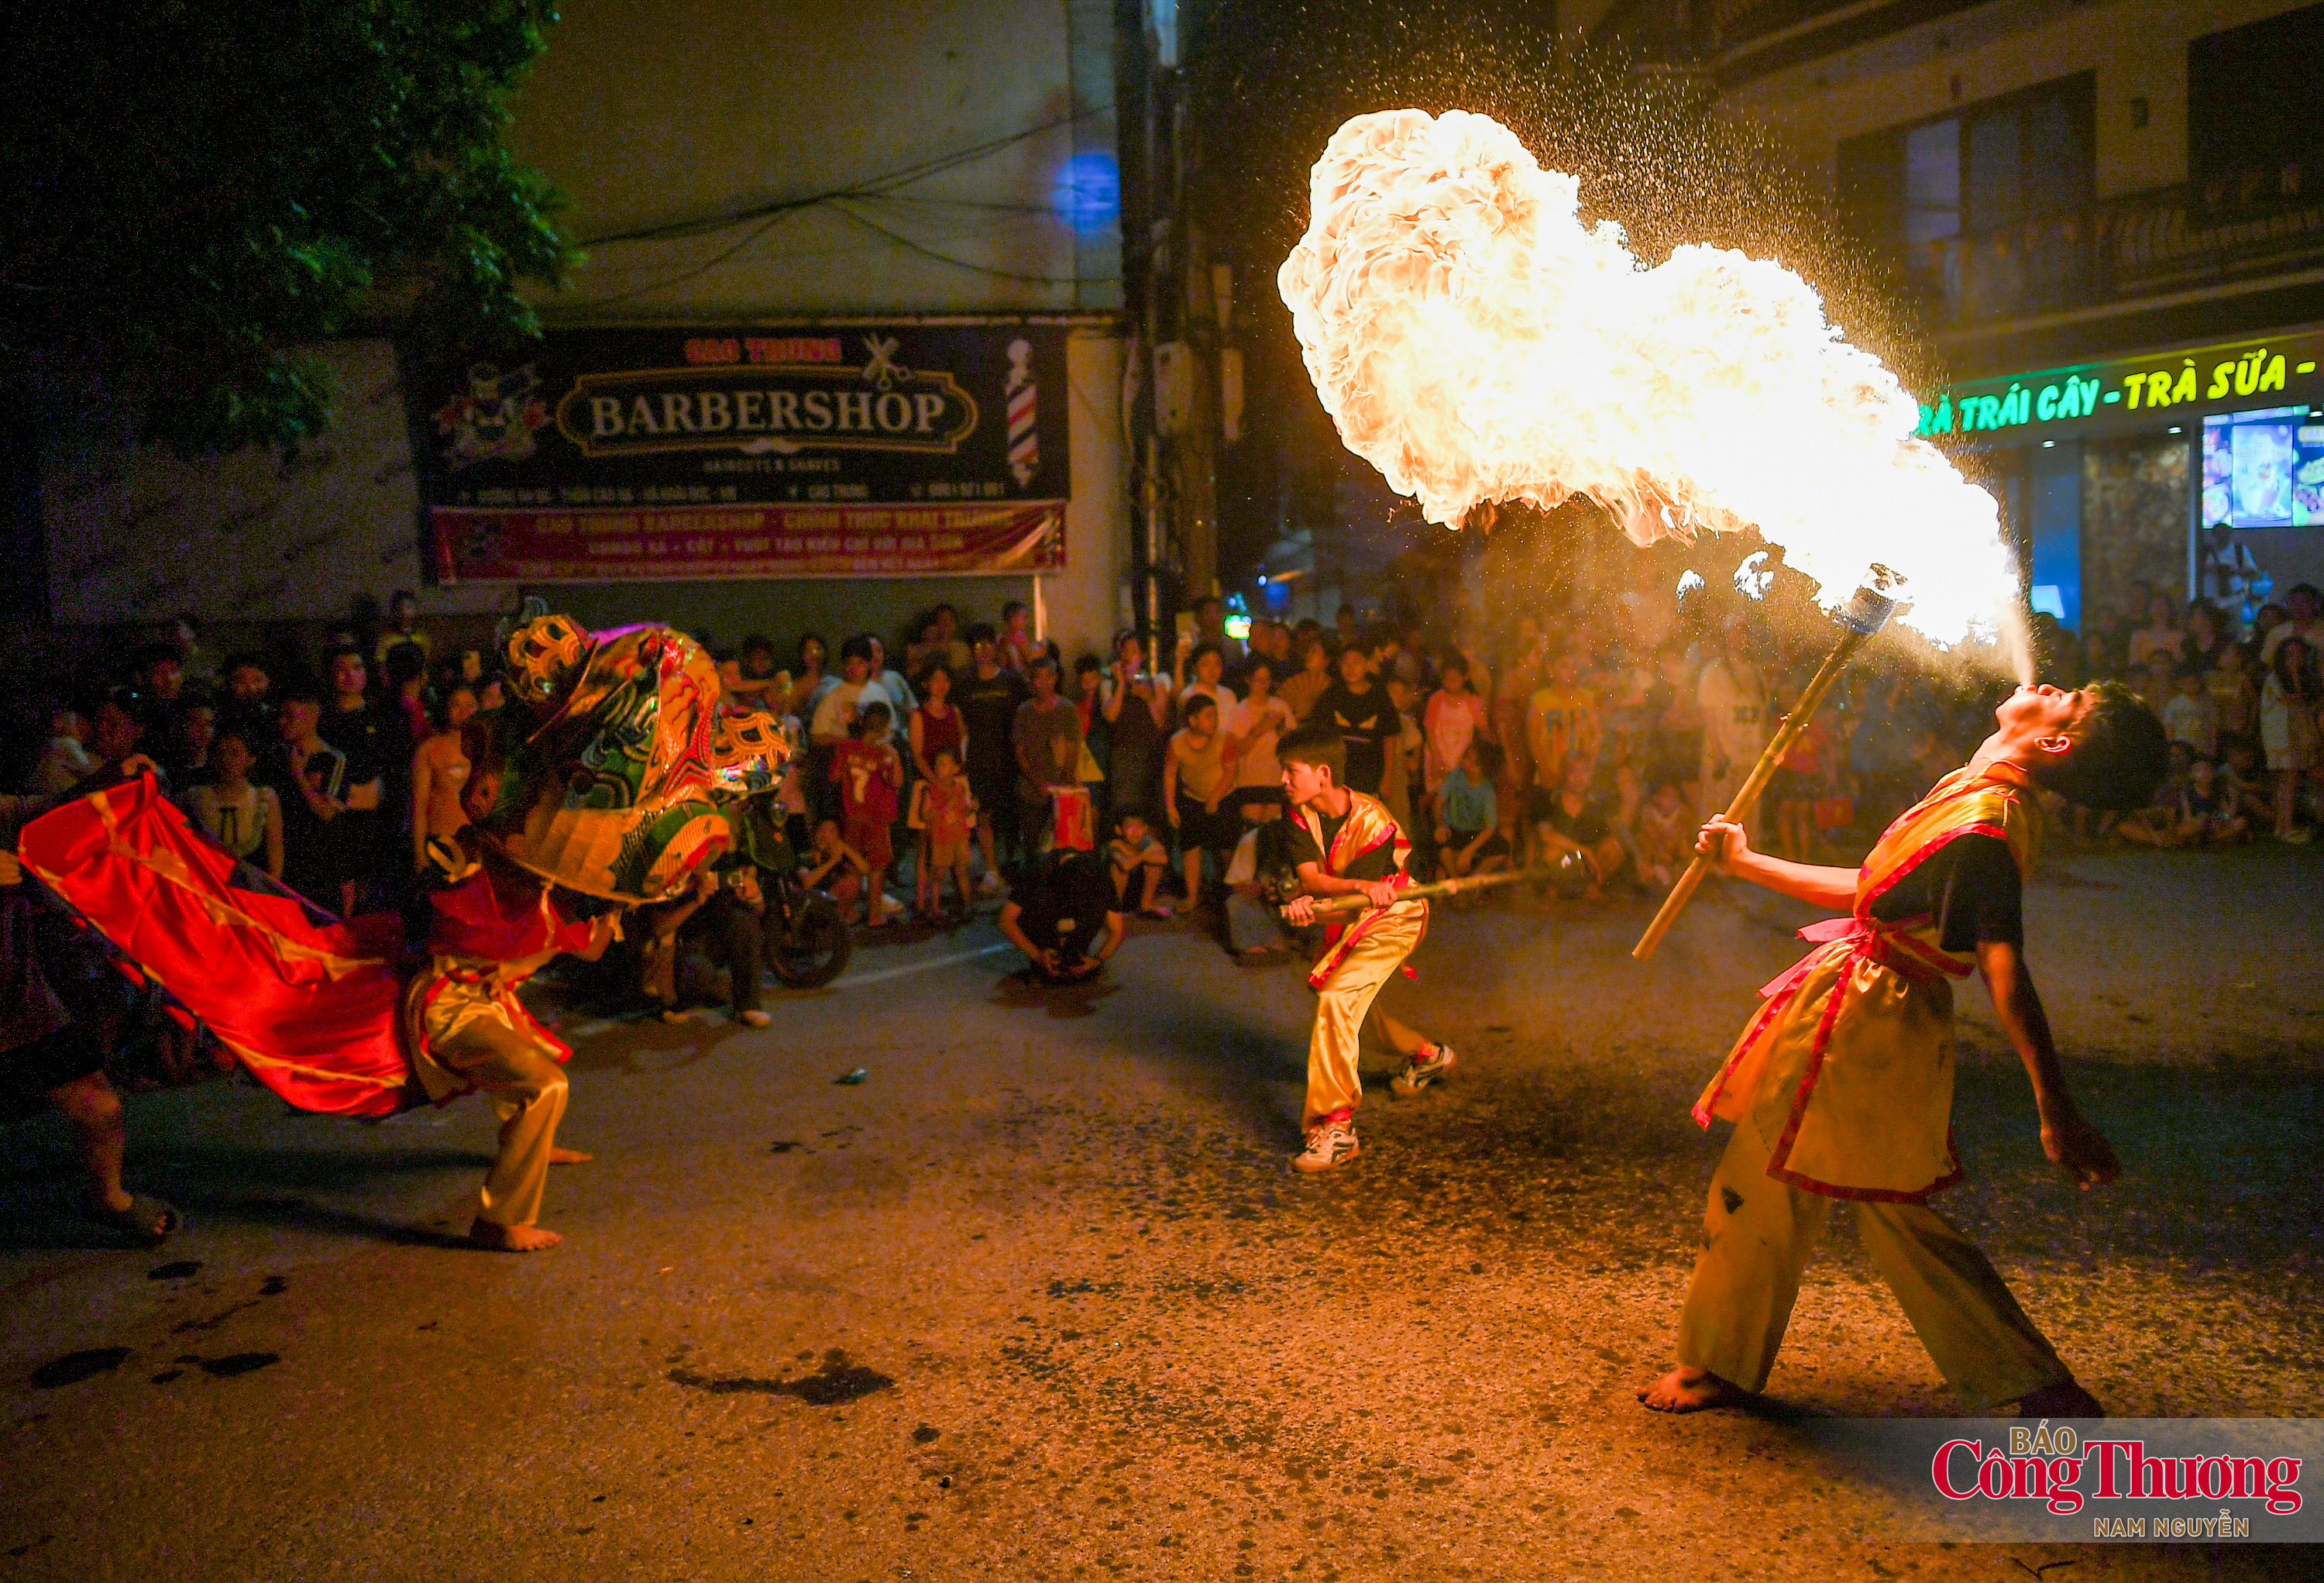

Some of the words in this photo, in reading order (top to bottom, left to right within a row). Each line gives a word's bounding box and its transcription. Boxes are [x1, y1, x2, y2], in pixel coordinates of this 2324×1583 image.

[592, 391, 946, 437] BARBERSHOP
[1958, 382, 2031, 432] TRÁI
[2036, 373, 2101, 422] CÂY
[2123, 357, 2198, 410] TRÀ
[2207, 347, 2286, 400] SỮA
